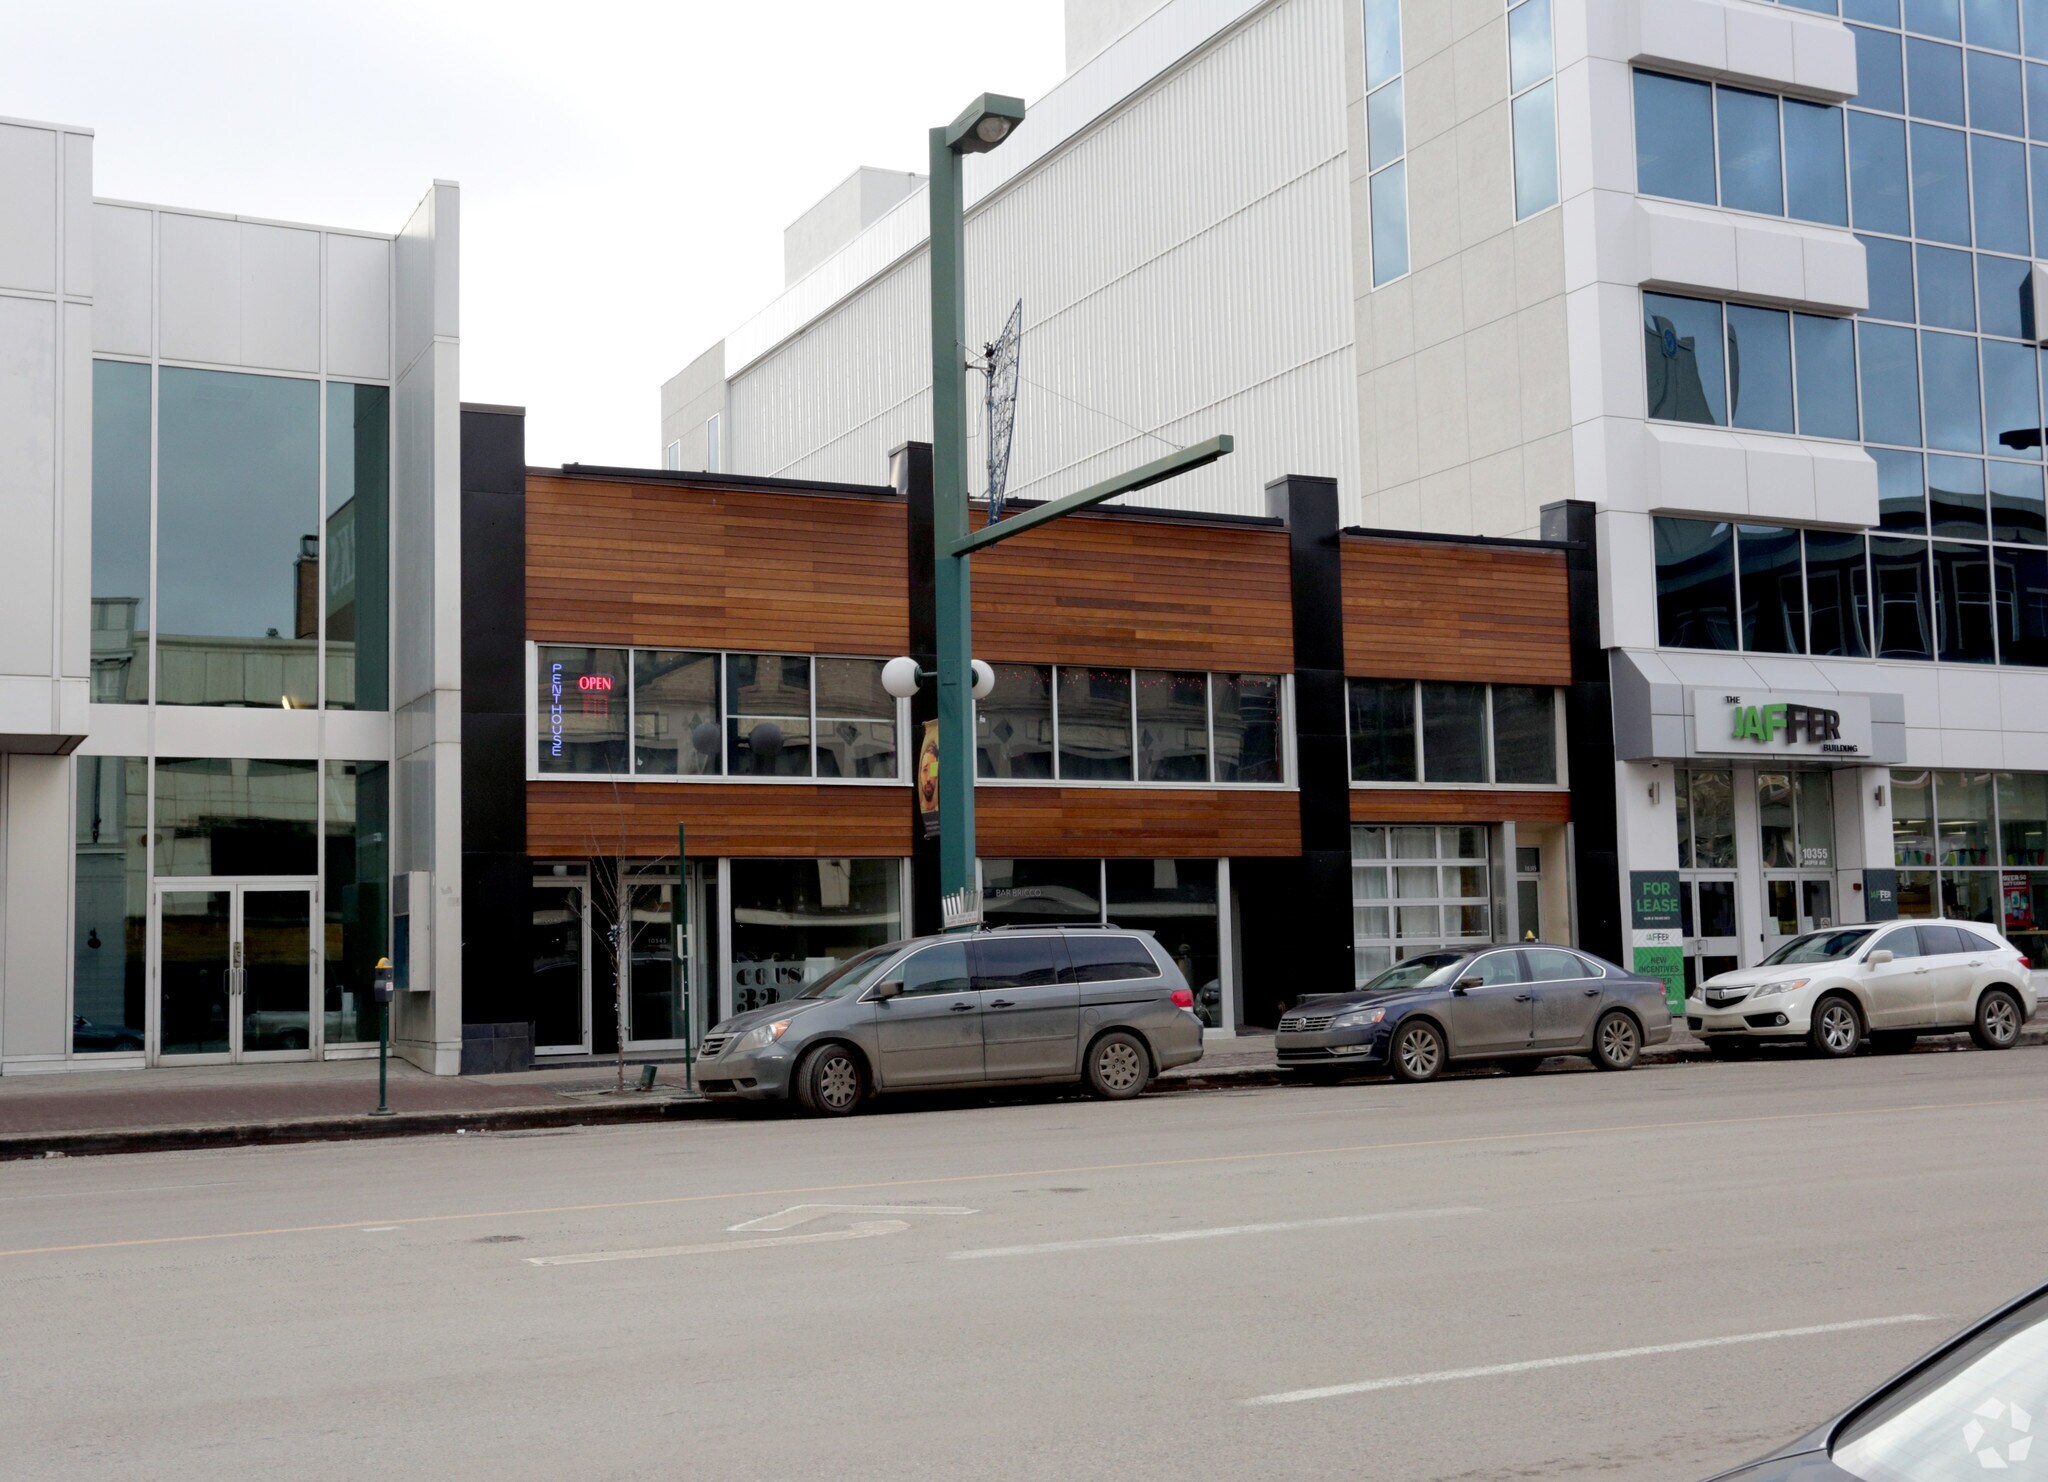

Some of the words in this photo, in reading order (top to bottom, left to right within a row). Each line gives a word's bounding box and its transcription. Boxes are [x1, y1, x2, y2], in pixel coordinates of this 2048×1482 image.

[578, 676, 612, 690] OPEN
[1724, 695, 1741, 704] THE
[551, 663, 562, 757] PENTHOUSE
[1732, 703, 1842, 744] JAFFER
[1823, 743, 1858, 753] BUILDING
[1802, 848, 1828, 859] 10355
[995, 888, 1011, 897] BAR
[1013, 888, 1042, 897] BRICCO
[1643, 882, 1671, 895] FOR
[1636, 899, 1679, 912] LEASE
[1639, 965, 1679, 973] INCENTIVES
